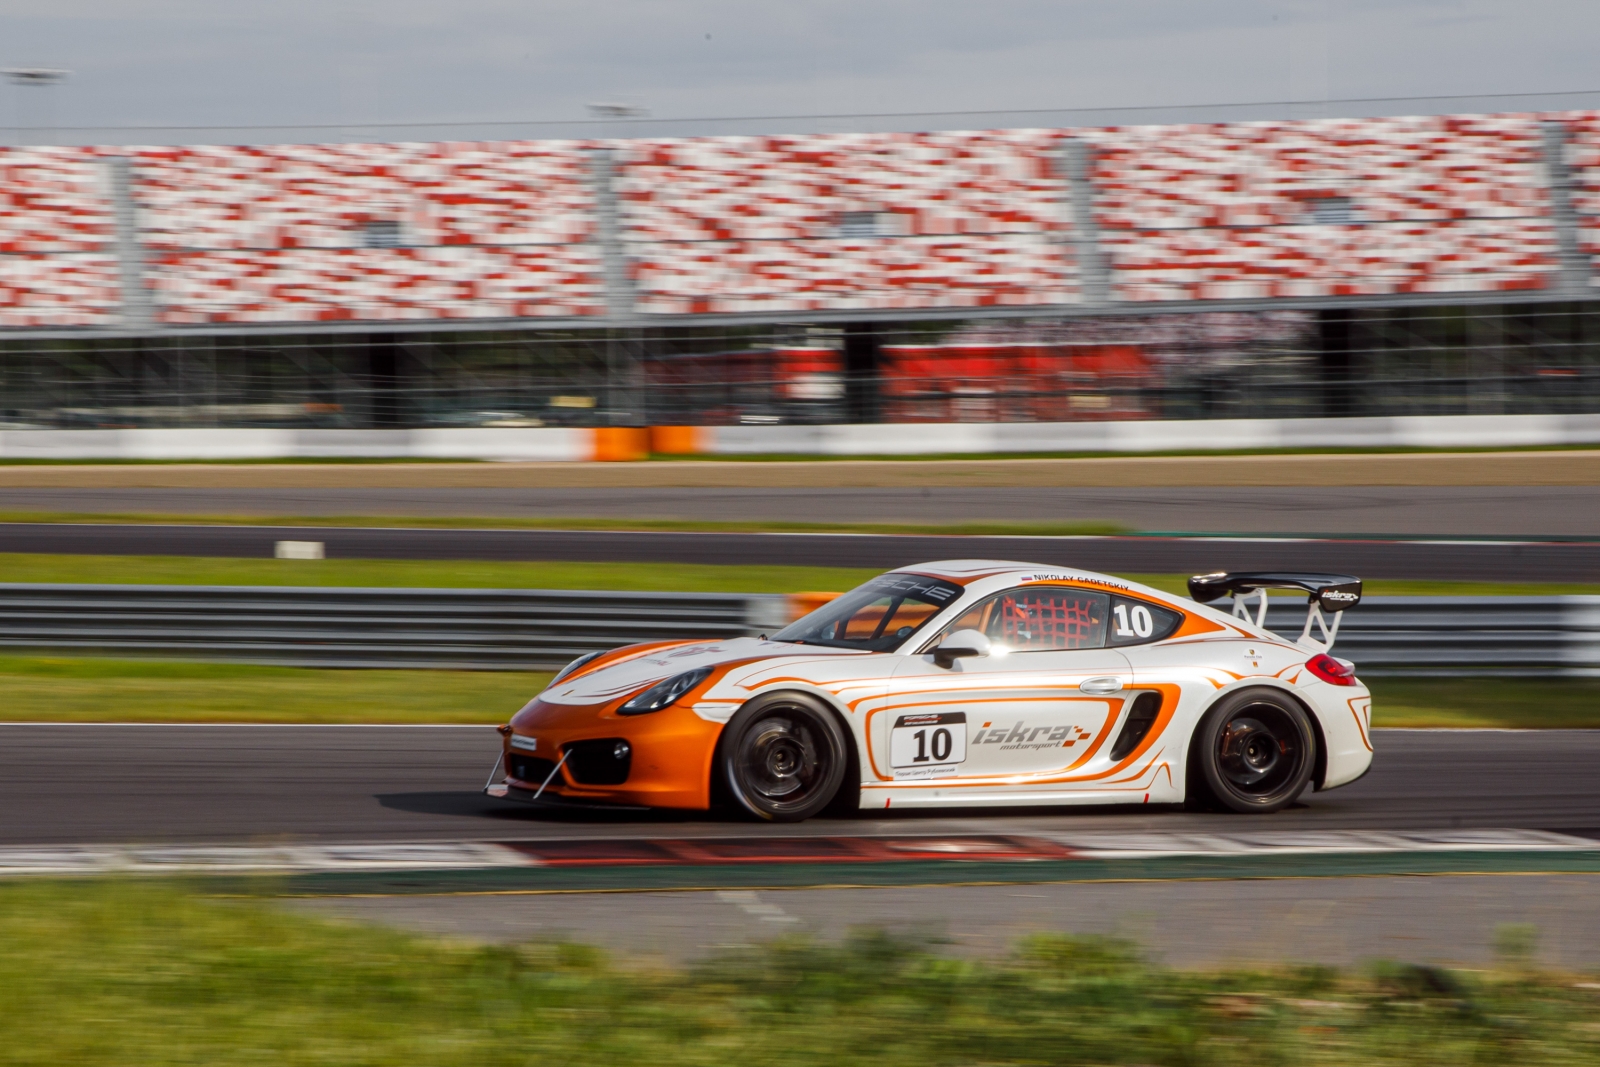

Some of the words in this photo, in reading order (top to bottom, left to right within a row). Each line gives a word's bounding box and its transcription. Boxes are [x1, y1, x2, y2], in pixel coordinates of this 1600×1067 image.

[1033, 574, 1074, 582] NIKOLAY
[1113, 604, 1153, 638] 10
[971, 721, 1073, 745] iskra
[913, 728, 952, 763] 10
[999, 742, 1061, 751] motorsport
